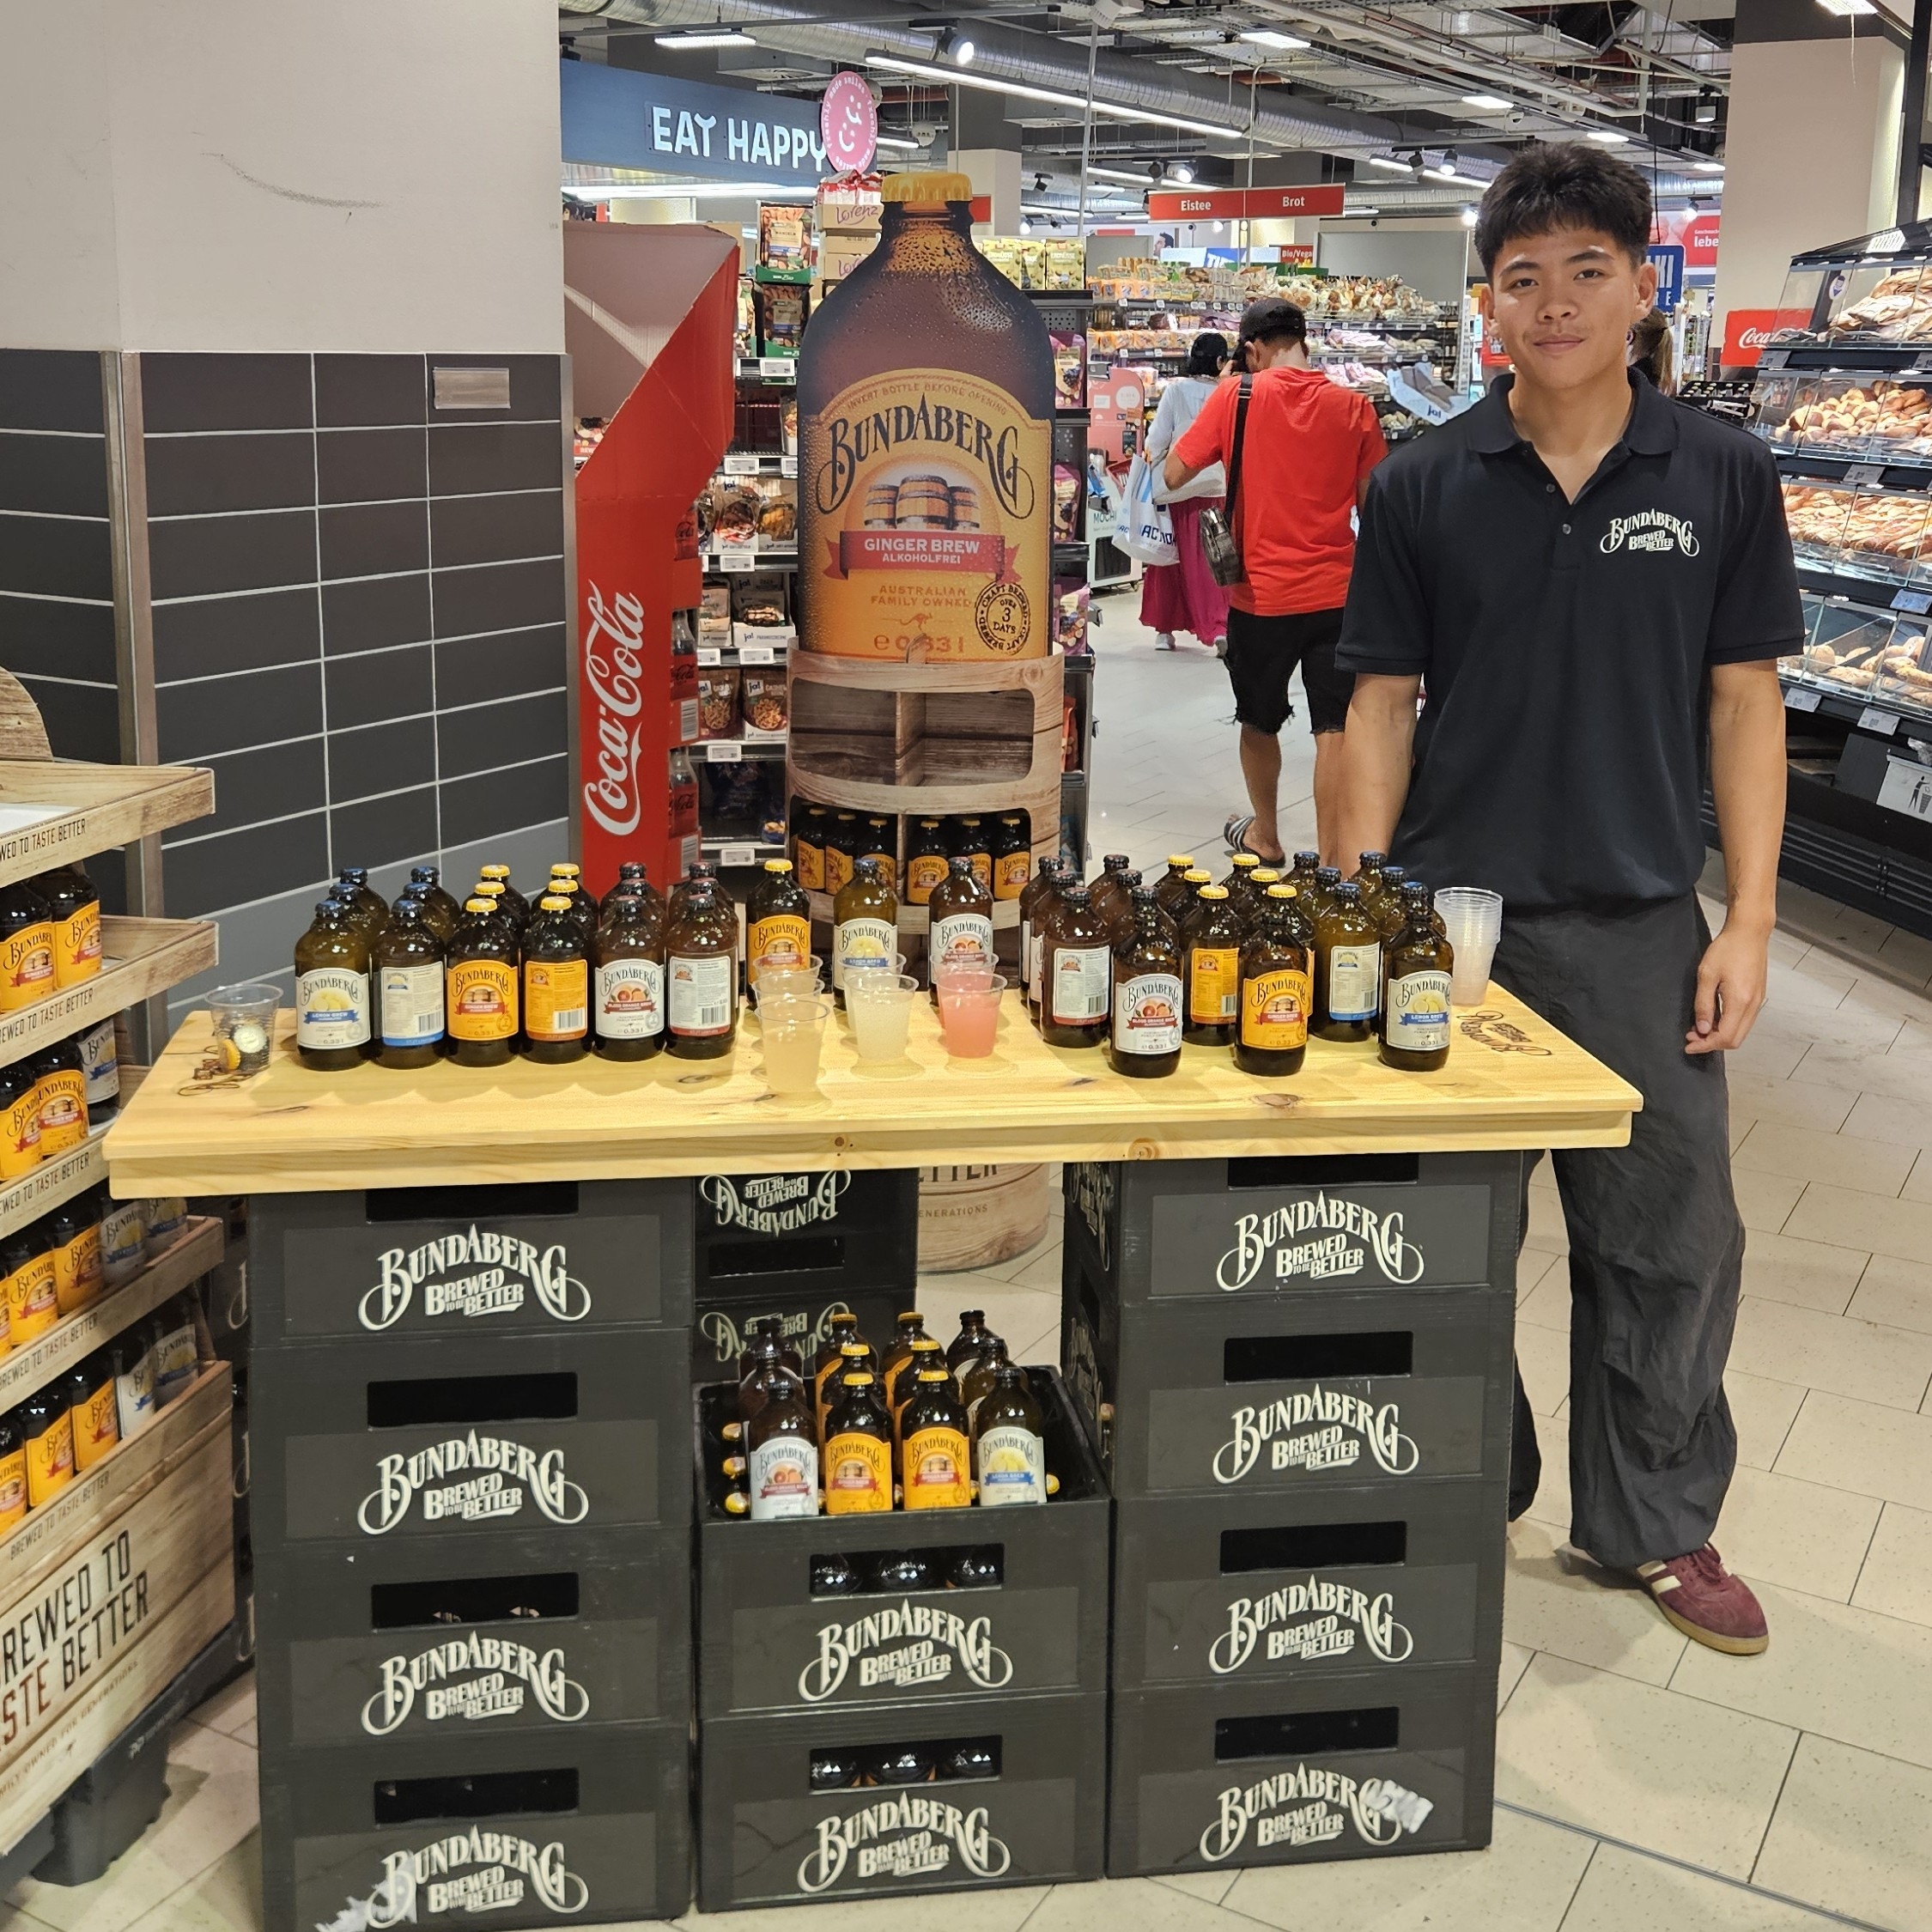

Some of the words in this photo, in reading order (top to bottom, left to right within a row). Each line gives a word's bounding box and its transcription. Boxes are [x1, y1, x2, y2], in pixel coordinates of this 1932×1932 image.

[653, 106, 717, 157] EAT
[727, 118, 827, 172] HAPPY
[835, 205, 879, 225] Lorenz
[1181, 199, 1212, 211] Eistee
[1282, 196, 1305, 207] Brot
[1694, 235, 1719, 247] lebe
[847, 391, 880, 410] INVERT
[882, 382, 920, 395] BOTTLE
[923, 382, 965, 398] BEFORE
[968, 391, 1006, 416] OPENING
[816, 392, 1035, 519] BUNDABERG
[864, 538, 927, 552] GINGER
[931, 539, 981, 554] BREW
[1600, 507, 1700, 556] BUNDABERG
[1628, 530, 1666, 550] BREWED
[1645, 538, 1674, 551] BETTER
[882, 552, 961, 564] ALKOHOLFREI
[870, 595, 920, 606] FAMILY
[923, 596, 973, 608] OWNED
[879, 584, 967, 597] AUSTRALIAN
[981, 585, 1005, 607] CRAFT
[999, 598, 1018, 609] OVER
[993, 621, 1017, 635] DAYS
[1001, 607, 1012, 622] 3
[584, 578, 645, 836] Coca-Cola
[0, 841, 16, 861] WED
[20, 836, 29, 855] TO
[32, 828, 56, 851] TASTE
[58, 818, 86, 841] BETTER
[754, 921, 809, 951] BUNDABERG
[838, 925, 895, 953] BUNDABERG
[937, 920, 993, 950] BUNDABERG
[301, 975, 364, 1006] BUNDABERG
[452, 968, 514, 998] BUNDABERG
[600, 966, 661, 997] BUNDABERG
[1122, 981, 1182, 1012] BUNDABERG
[1251, 978, 1308, 1008] BUNDABERG
[1395, 978, 1451, 1008] BUNDABERG
[0, 1018, 24, 1044] EWED
[27, 1012, 37, 1031] TO
[40, 1000, 64, 1025] TASTE
[66, 987, 94, 1013] BETTER
[38, 1078, 84, 1103] UNDABERG
[23, 1183, 33, 1200] TO
[36, 1169, 59, 1194] TASTE
[62, 1152, 89, 1180] BETTER
[744, 1176, 784, 1199] BETTER
[757, 1176, 809, 1208] BREWED
[699, 1169, 852, 1237] BUNDABERG
[918, 1203, 988, 1218] ENERATIONS
[1217, 1190, 1424, 1291] BUNDABERG
[1276, 1234, 1347, 1278] BREWED
[358, 1224, 592, 1330] BUNDABERG
[1309, 1248, 1364, 1279] BETTER
[425, 1268, 505, 1315] BREWED
[464, 1284, 525, 1317] BETTER
[32, 1352, 42, 1368] TO
[45, 1336, 69, 1361] TASTE
[70, 1312, 98, 1342] BETTER
[1212, 1383, 1419, 1484] BUNDABERG
[1272, 1425, 1343, 1471] BREWED
[756, 1447, 814, 1481] BUNDABERG
[827, 1442, 886, 1473] BUNDABERG
[908, 1436, 967, 1468] BUNDABERG
[979, 1434, 1038, 1468] BUNDABERG
[1306, 1439, 1360, 1472] BETTER
[357, 1428, 589, 1534] BUNDABERG
[424, 1473, 503, 1520] BREWED
[10, 1523, 44, 1560] BREWED
[46, 1514, 56, 1534] TO
[58, 1495, 81, 1523] TASTE
[82, 1470, 110, 1503] BETTER
[463, 1487, 522, 1521] BETTER
[2, 1563, 92, 1686] REWED
[101, 1529, 131, 1593] TO
[1208, 1573, 1414, 1674] BUNDABERG
[799, 1598, 1014, 1702] BUNDABERG
[1267, 1614, 1339, 1660] BREWED
[1300, 1629, 1356, 1662] BETTER
[2, 1658, 52, 1747] STE
[63, 1570, 149, 1692] BETTER
[860, 1640, 934, 1686] BREWED
[895, 1654, 951, 1686] BETTER
[361, 1630, 590, 1735] BUNDABERG
[426, 1672, 505, 1720] BREWED
[465, 1686, 525, 1720] BETTER
[1257, 1801, 1327, 1847] BREWED
[1290, 1814, 1346, 1848] BETTER
[798, 1790, 1012, 1893] BUNDABERG
[859, 1831, 933, 1878] BREWED
[365, 1824, 590, 1929] BUNDABERG
[892, 1844, 950, 1877] BETTER
[428, 1865, 505, 1913] BREWED
[465, 1879, 524, 1914] BETTER
